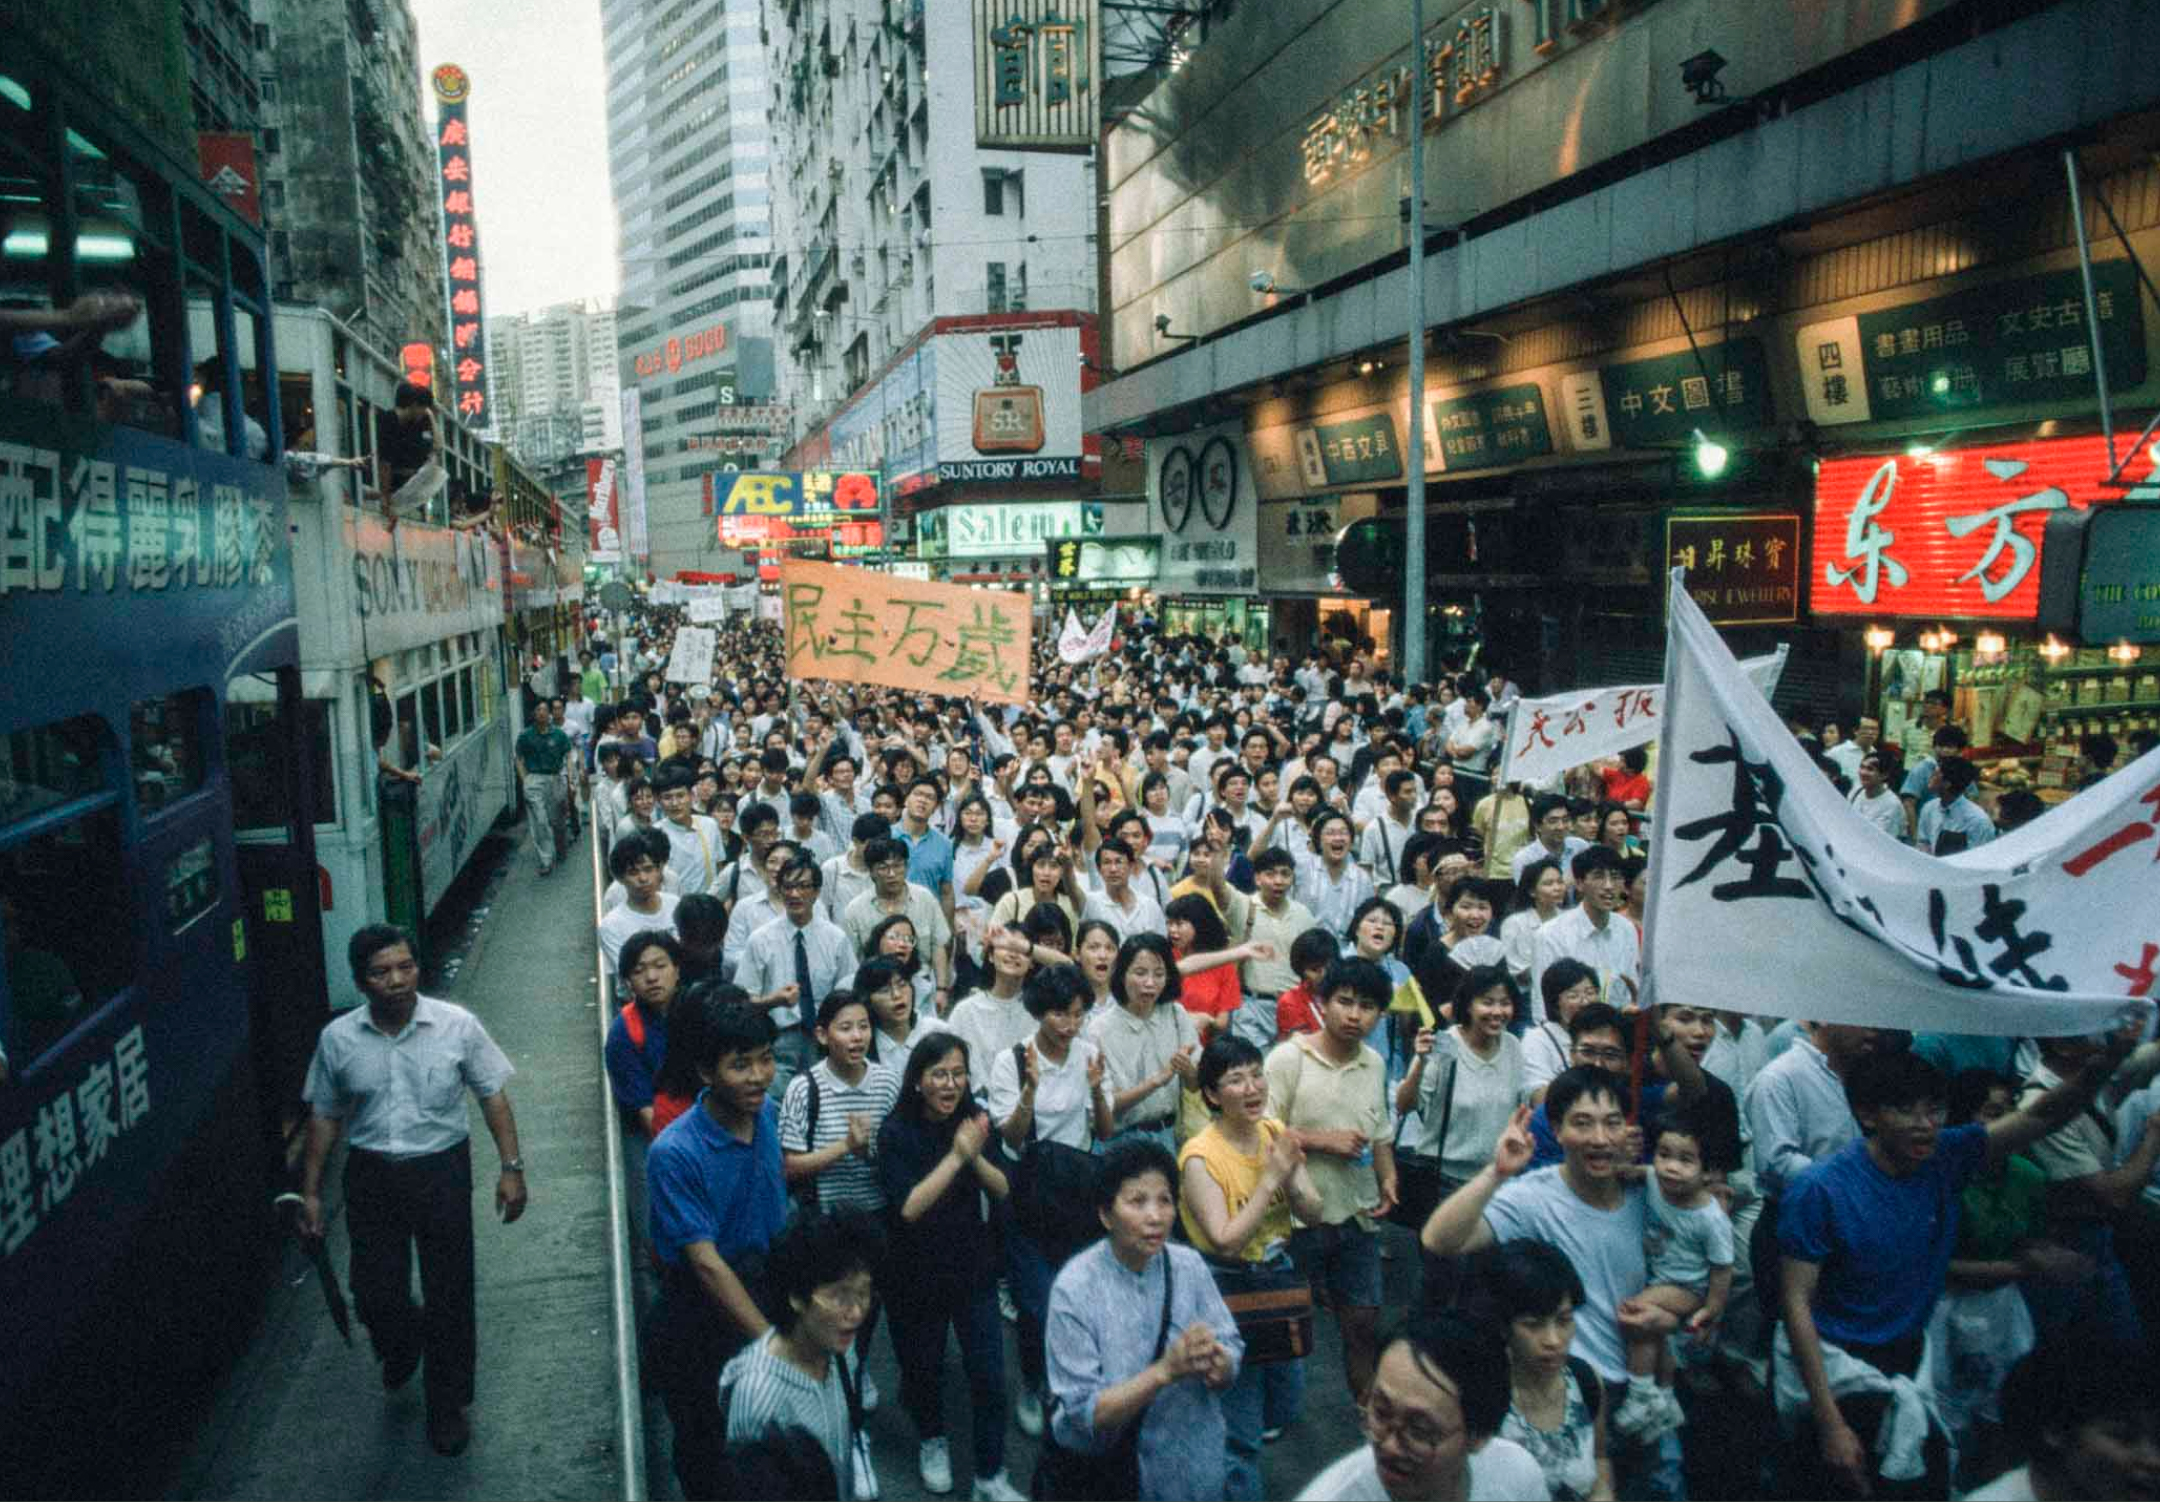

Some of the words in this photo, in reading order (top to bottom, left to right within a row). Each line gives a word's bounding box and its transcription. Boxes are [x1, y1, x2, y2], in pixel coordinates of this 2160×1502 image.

[1818, 340, 1849, 407] 四樓
[940, 462, 1018, 480] SUNTORY
[1022, 459, 1080, 477] ROYAL
[723, 475, 793, 513] ABC
[958, 506, 1056, 542] Salem
